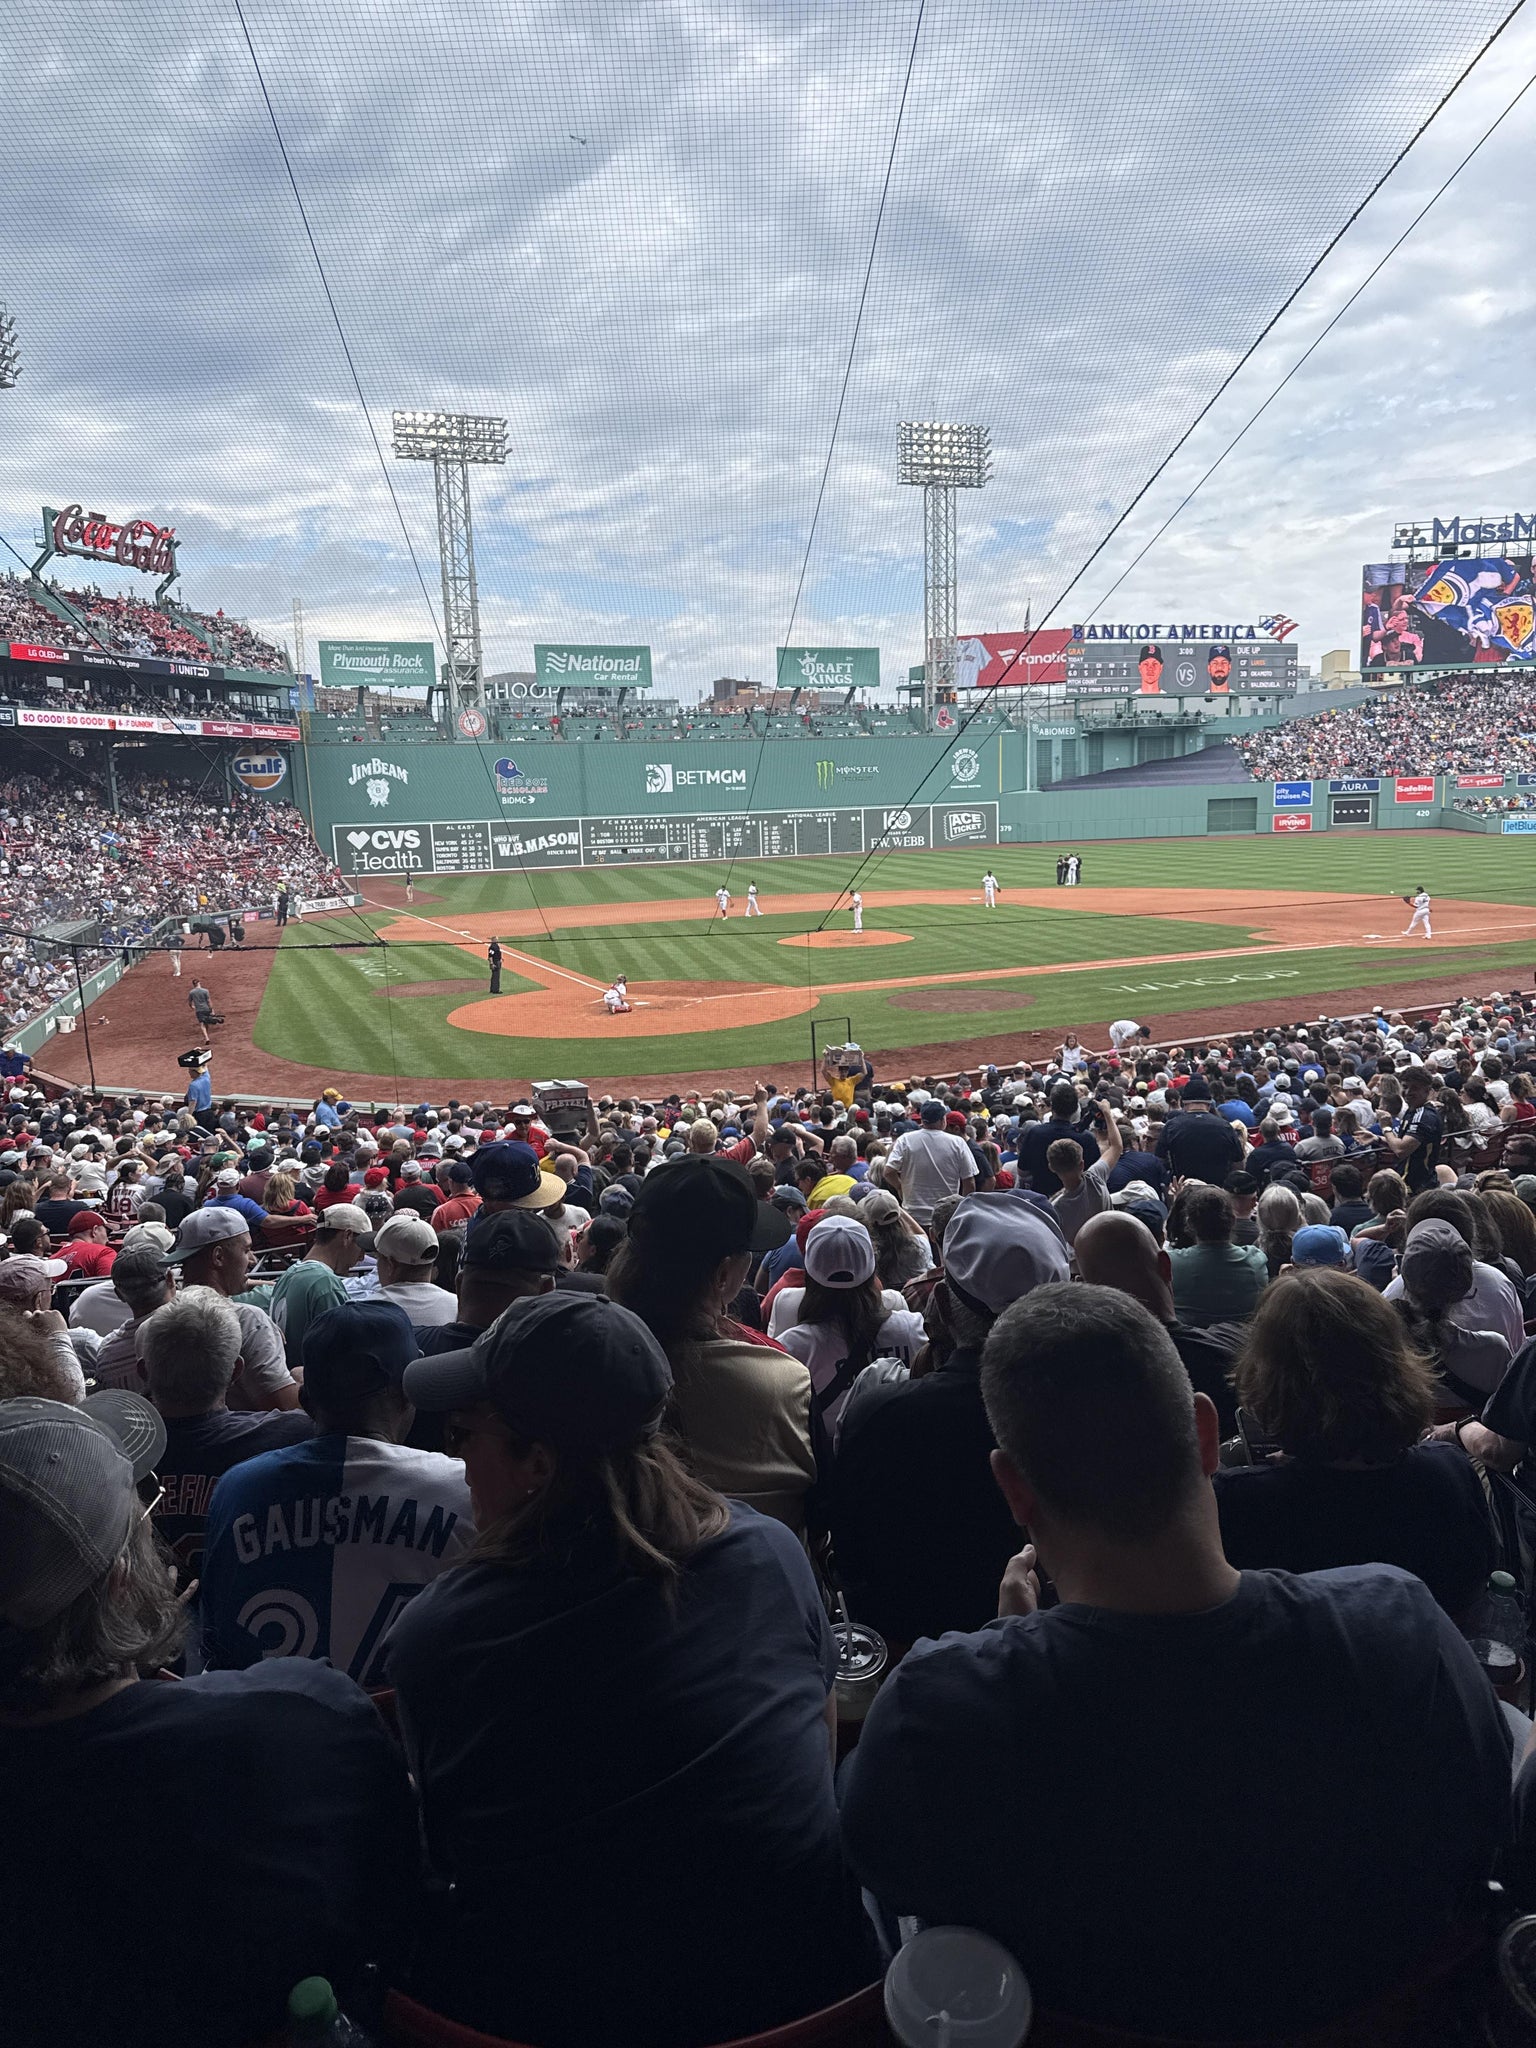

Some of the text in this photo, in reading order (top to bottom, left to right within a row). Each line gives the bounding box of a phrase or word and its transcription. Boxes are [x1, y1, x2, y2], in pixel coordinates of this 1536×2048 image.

[1072, 624, 1257, 639] BANK OF AMERICA
[38, 650, 56, 658] OLED
[333, 653, 423, 668] Plymouth Rock
[567, 654, 640, 672] National
[178, 666, 209, 677] UNITED
[801, 663, 854, 676] DRAFT
[1179, 669, 1193, 681] VS
[594, 673, 638, 681] Car Rental
[809, 673, 853, 684] KINGS
[23, 714, 35, 722] SO
[37, 714, 66, 724] GOOD!
[67, 716, 78, 724] SO
[80, 716, 105, 726] GOOD!
[1039, 727, 1076, 736] ABIOMED
[234, 758, 282, 773] Gulf
[348, 758, 408, 785] JIM BEAM
[836, 766, 879, 774] MONSTER
[501, 778, 548, 786] RED SOX
[676, 770, 746, 785] BETMGM
[1475, 777, 1503, 786] TICKET
[501, 786, 548, 794] SCHOLARS
[1397, 784, 1433, 792] Safelite
[502, 796, 527, 804] BIDMC
[883, 810, 912, 830] 160
[952, 812, 982, 826] ACE
[953, 823, 982, 834] TICKET
[1506, 821, 1536, 832] jetBlue
[371, 829, 421, 850] CVS
[892, 836, 925, 848] WEBB
[351, 851, 423, 870] Health
[545, 1098, 588, 1112] PRETZEL
[1314, 1175, 1328, 1185] 38
[232, 1495, 458, 1565] GAUSMAN
